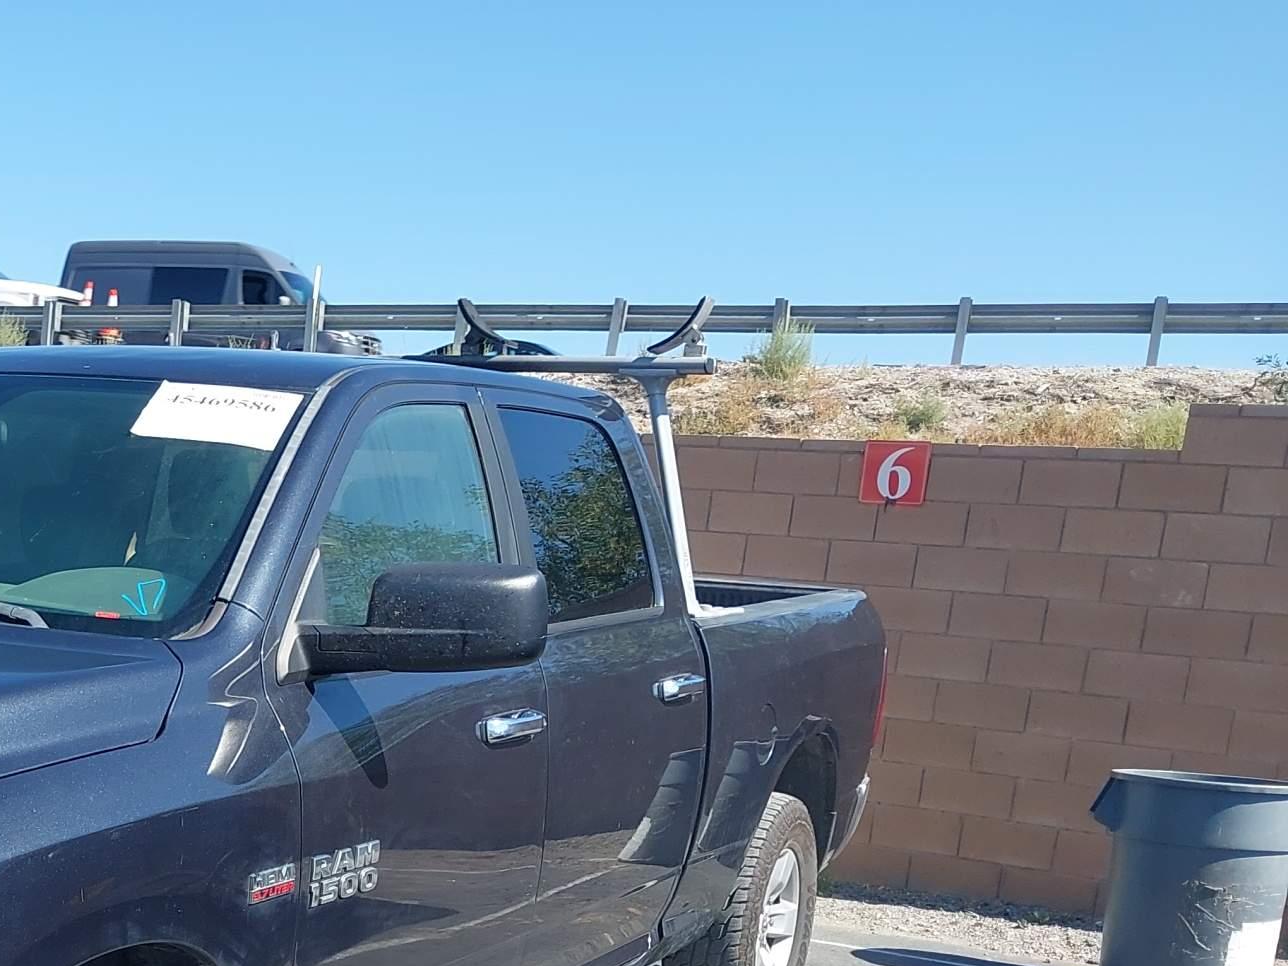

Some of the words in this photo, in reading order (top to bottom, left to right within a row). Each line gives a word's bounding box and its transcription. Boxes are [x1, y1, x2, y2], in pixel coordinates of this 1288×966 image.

[877, 446, 916, 500] 6
[249, 862, 295, 892] HEMI
[310, 839, 380, 881] RAM
[309, 866, 379, 909] 1500
